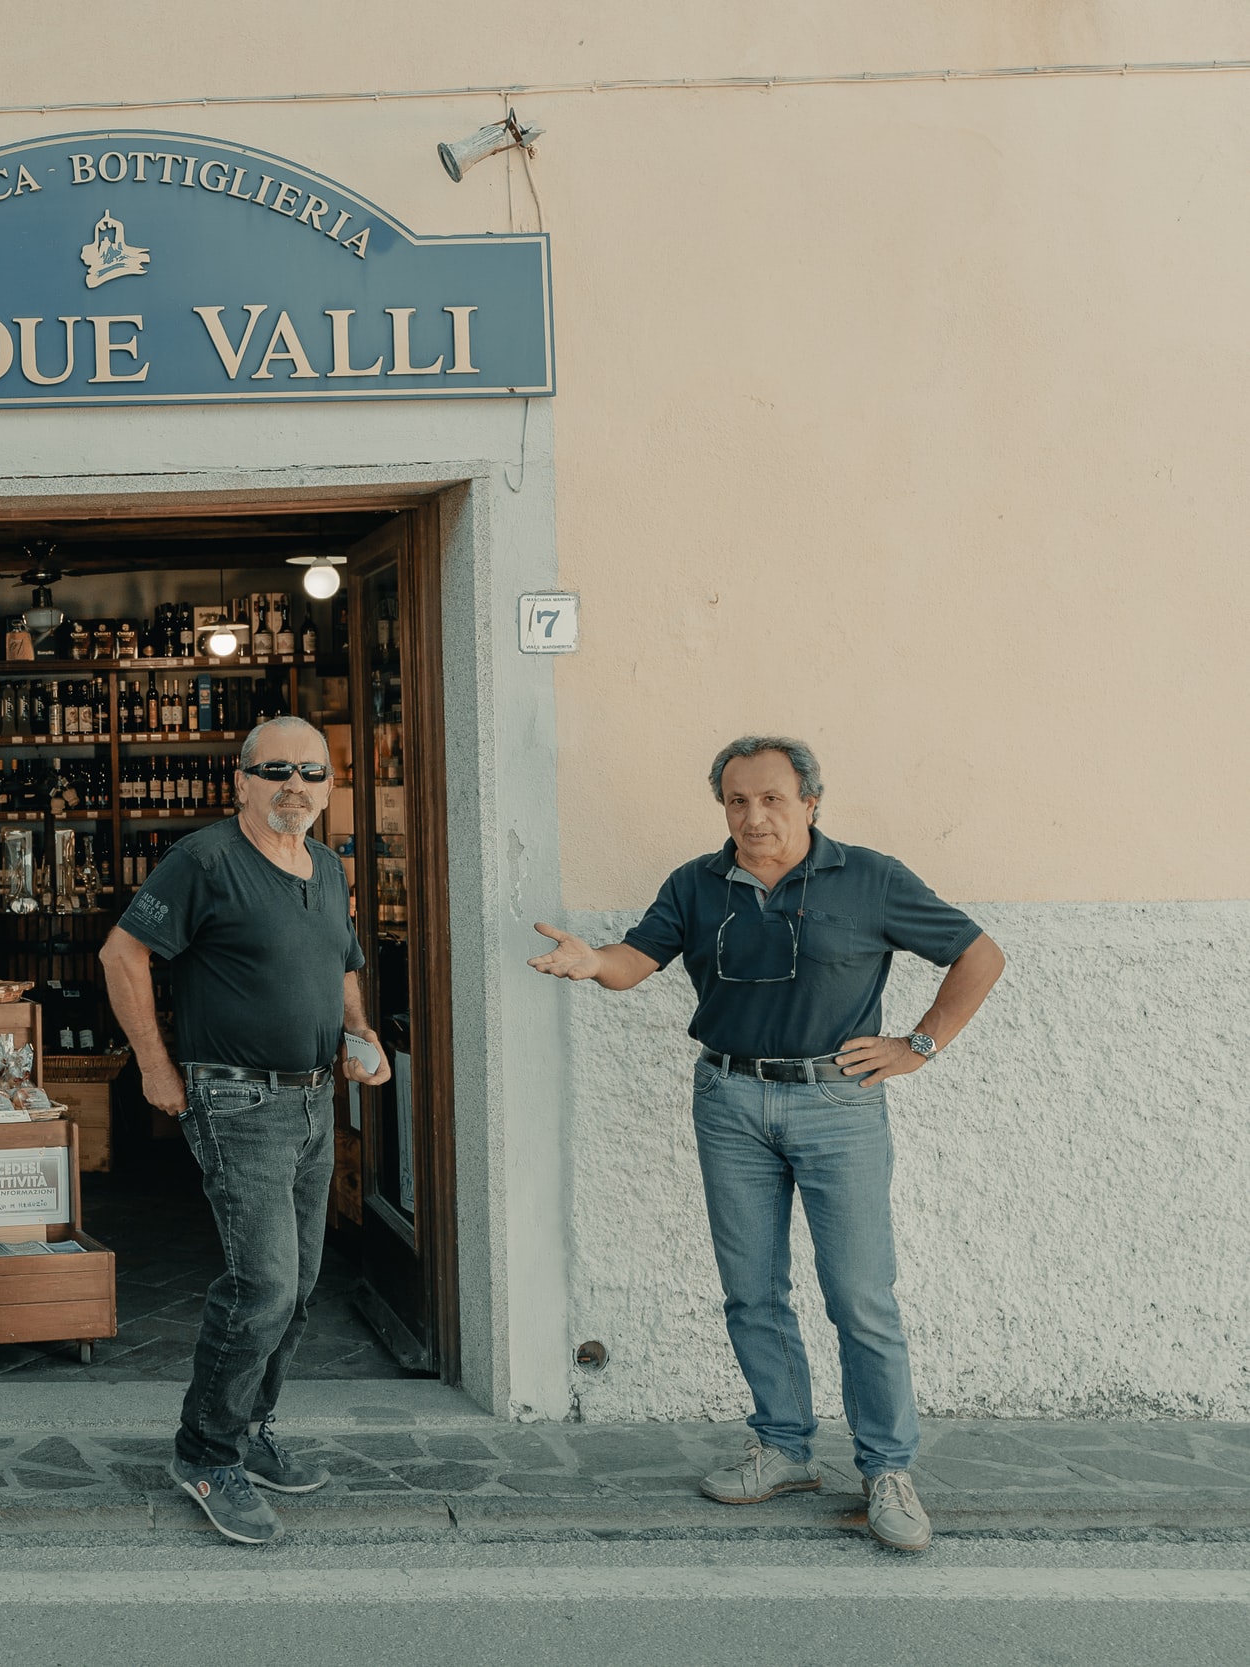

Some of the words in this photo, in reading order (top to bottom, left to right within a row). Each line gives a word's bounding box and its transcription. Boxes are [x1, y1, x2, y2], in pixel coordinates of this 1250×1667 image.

[69, 151, 373, 260] BOTTIGLIERIA
[193, 303, 481, 380] VALLI
[536, 610, 560, 638] 7
[141, 892, 156, 906] JACK
